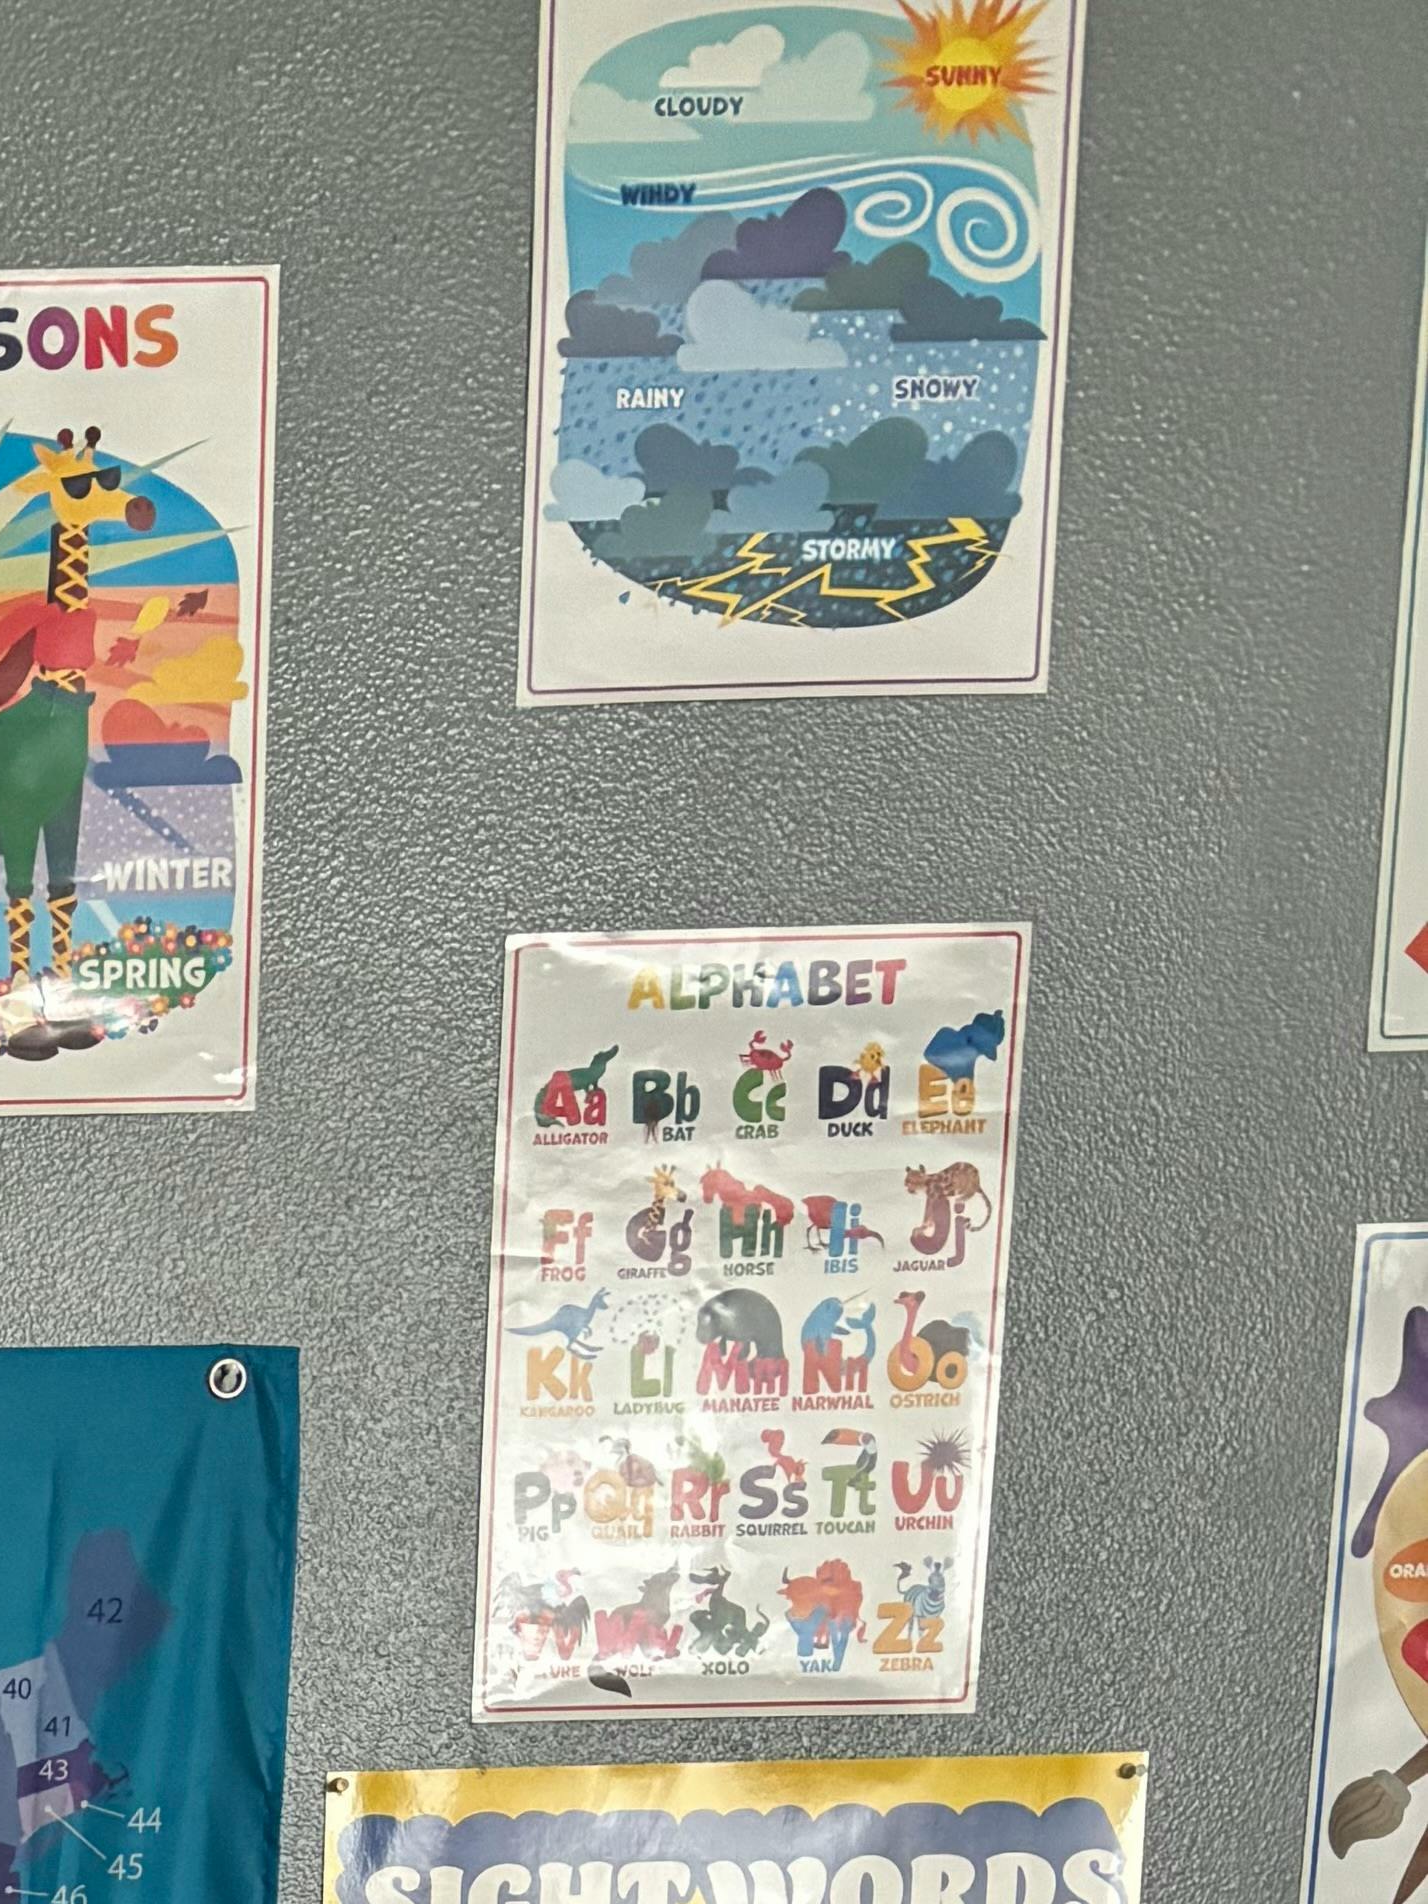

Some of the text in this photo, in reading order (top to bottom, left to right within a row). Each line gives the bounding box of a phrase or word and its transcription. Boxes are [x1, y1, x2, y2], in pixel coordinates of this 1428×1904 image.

[925, 65, 1002, 85] SUNNY
[655, 96, 743, 117] CLOUDY
[621, 183, 696, 206] WINDY
[894, 376, 978, 400] SNOWY
[616, 388, 684, 409] RAINY
[802, 539, 896, 560] STORMY
[103, 855, 231, 892] WINTER
[79, 957, 207, 991] SPRING
[628, 959, 906, 1011] ALPHABET
[662, 1126, 695, 1142] BAT
[735, 1125, 778, 1139] CRAB
[828, 1122, 873, 1137] DUCK
[902, 1118, 986, 1135] ELEPHANT
[533, 1132, 608, 1145] ALLIGATOR
[724, 1262, 774, 1276] HORSE
[824, 1259, 859, 1273] IBIS
[894, 1259, 945, 1273] JAGUAR
[542, 1267, 586, 1282] FROG
[702, 1398, 780, 1412] MANATEE
[792, 1395, 874, 1410] NARWHAL
[890, 1392, 961, 1408] OSTRICH
[614, 1402, 684, 1415] LADYBUG
[671, 1524, 725, 1537] RABBIT
[736, 1523, 807, 1537] SQUIRREL
[817, 1520, 875, 1535] TOUCAN
[894, 1516, 954, 1530] URCHIN
[1390, 1562, 1428, 1579] ORA
[87, 1597, 122, 1623] 42
[702, 1662, 749, 1675] XOLO
[800, 1660, 830, 1673] YAK
[880, 1657, 933, 1672] ZEBRA
[39, 1759, 68, 1780] 43
[128, 1808, 161, 1833] 44
